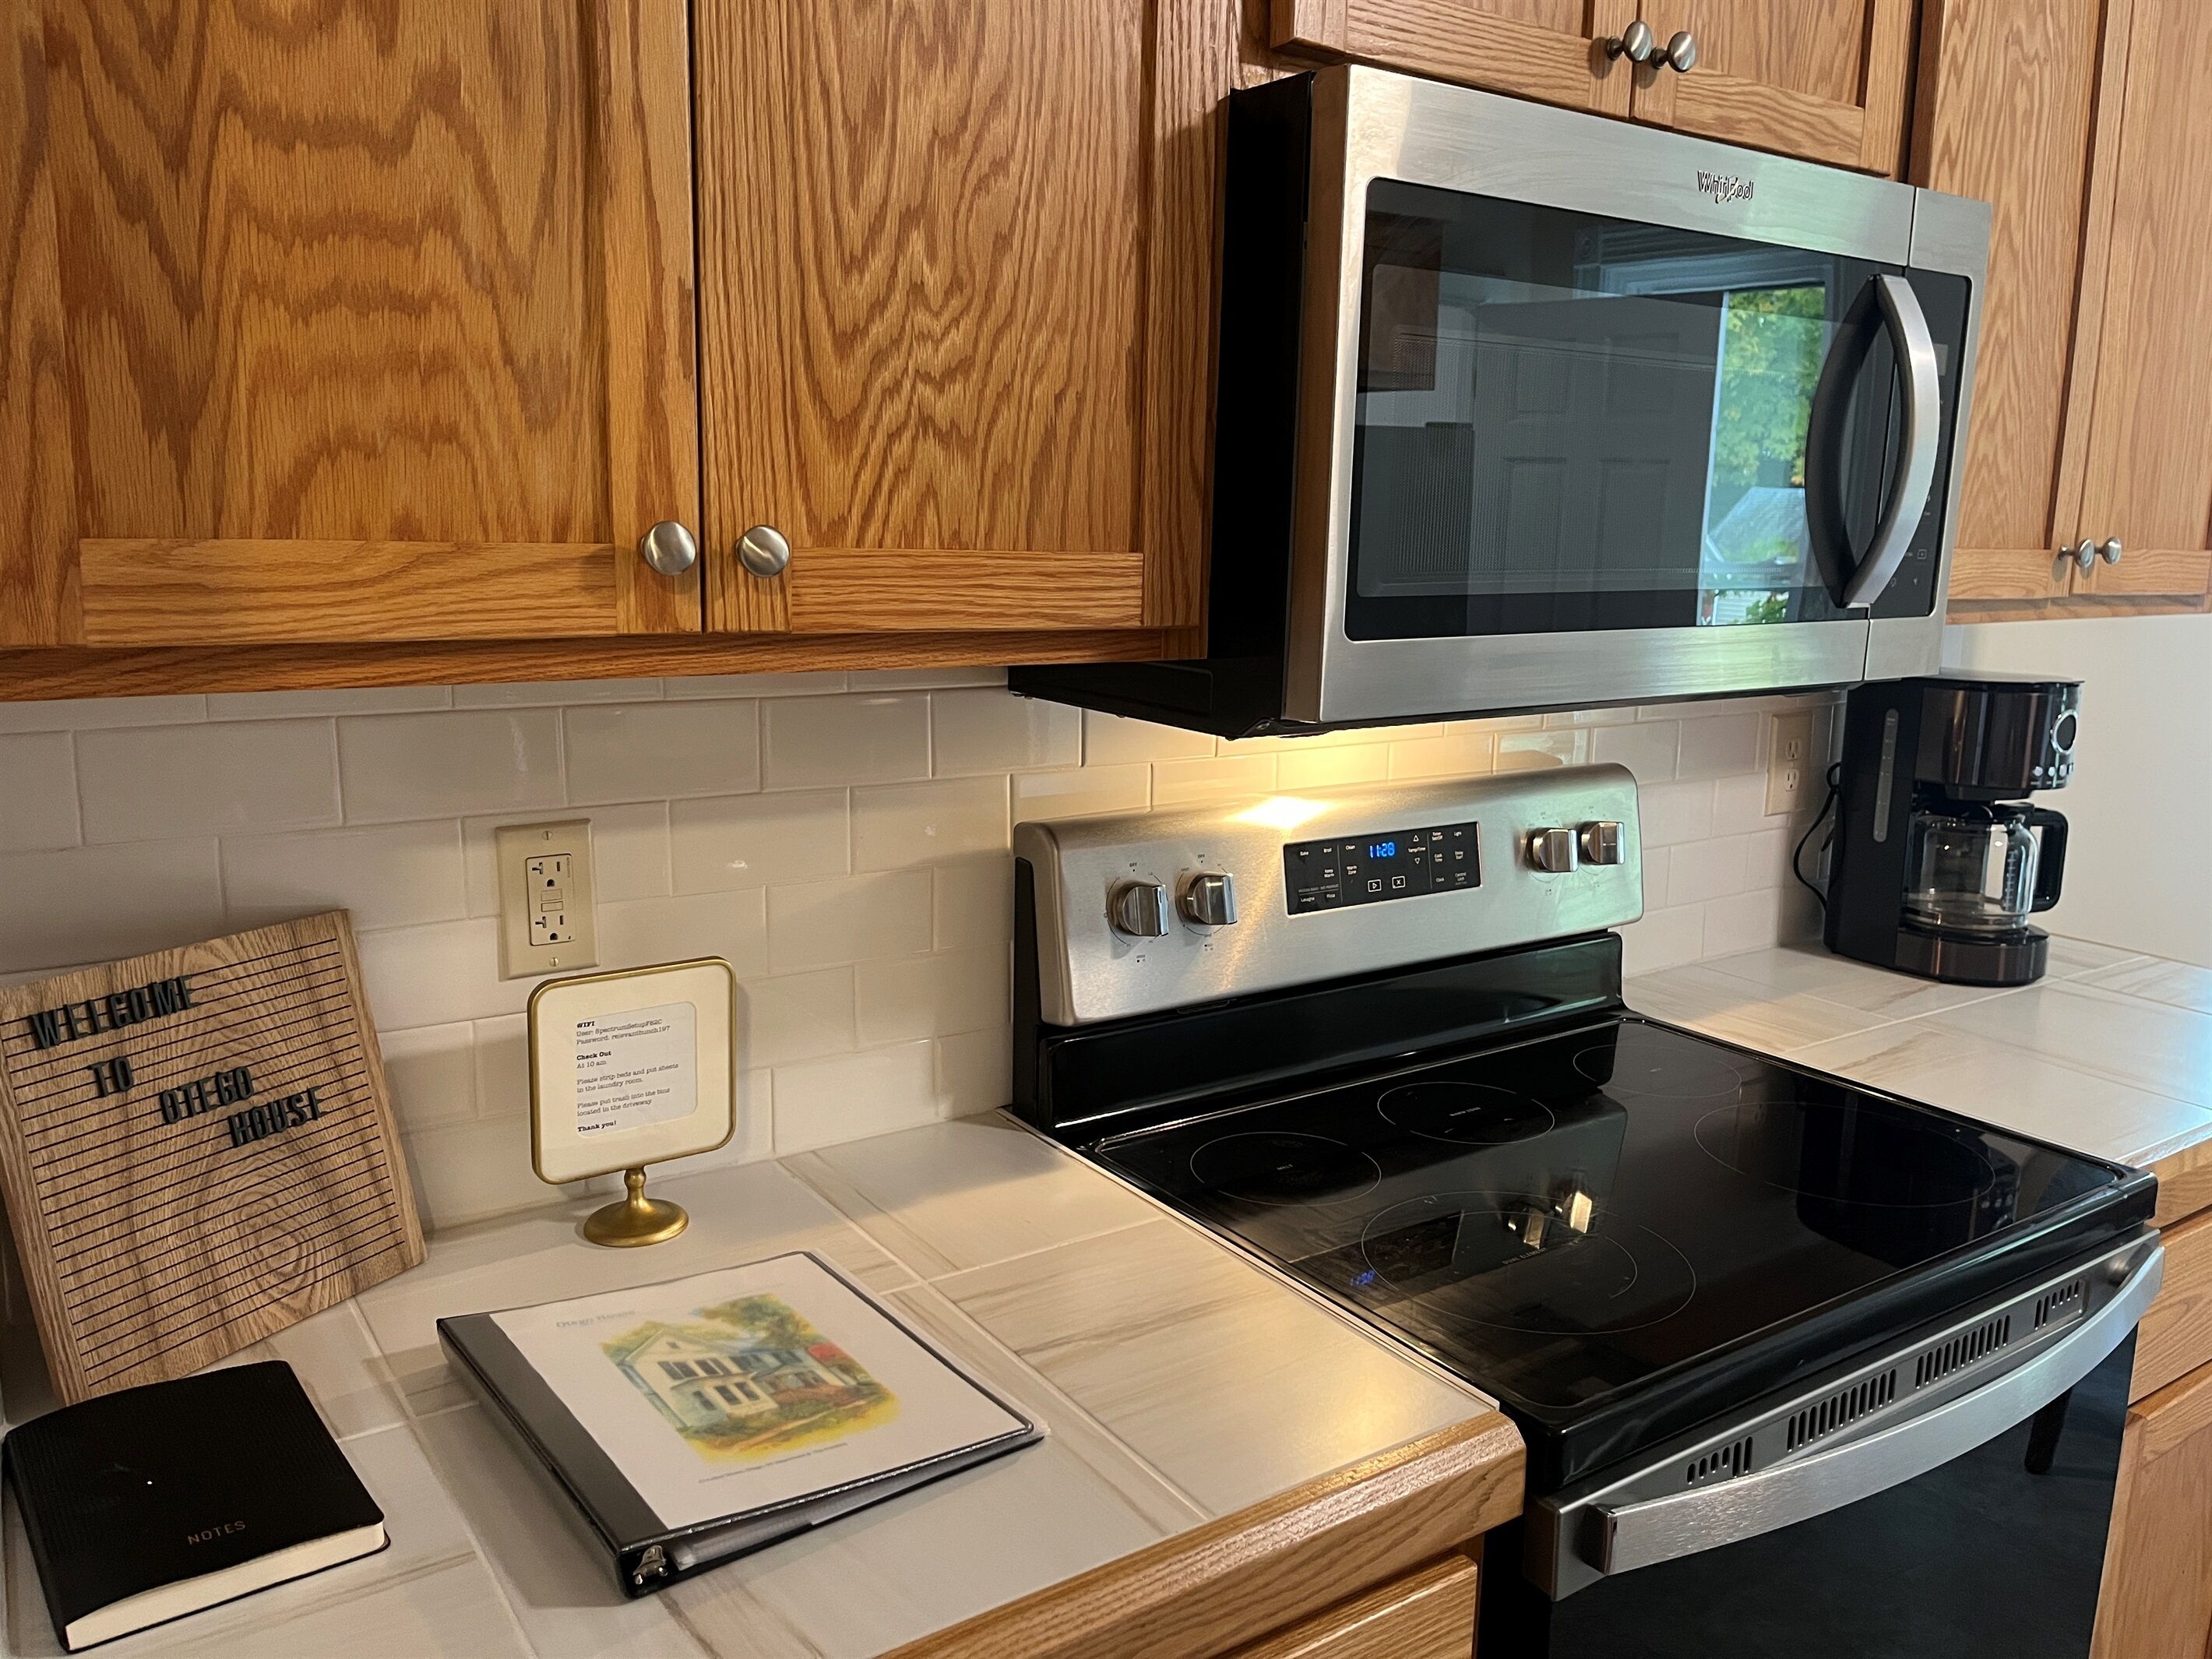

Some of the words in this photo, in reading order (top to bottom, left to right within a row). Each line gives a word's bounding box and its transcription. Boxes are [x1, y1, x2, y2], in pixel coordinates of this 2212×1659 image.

[1697, 170, 1754, 203] Whirlpool
[1369, 842, 1395, 858] 11:28
[33, 975, 200, 1049] WELCOME
[89, 1055, 136, 1098] TO
[597, 1080, 624, 1089] laundry
[160, 1066, 255, 1125] OTEGO
[228, 1085, 330, 1148] HOUSE
[577, 1107, 601, 1116] located
[601, 1120, 616, 1129] you!
[187, 1520, 246, 1545] NOTES
